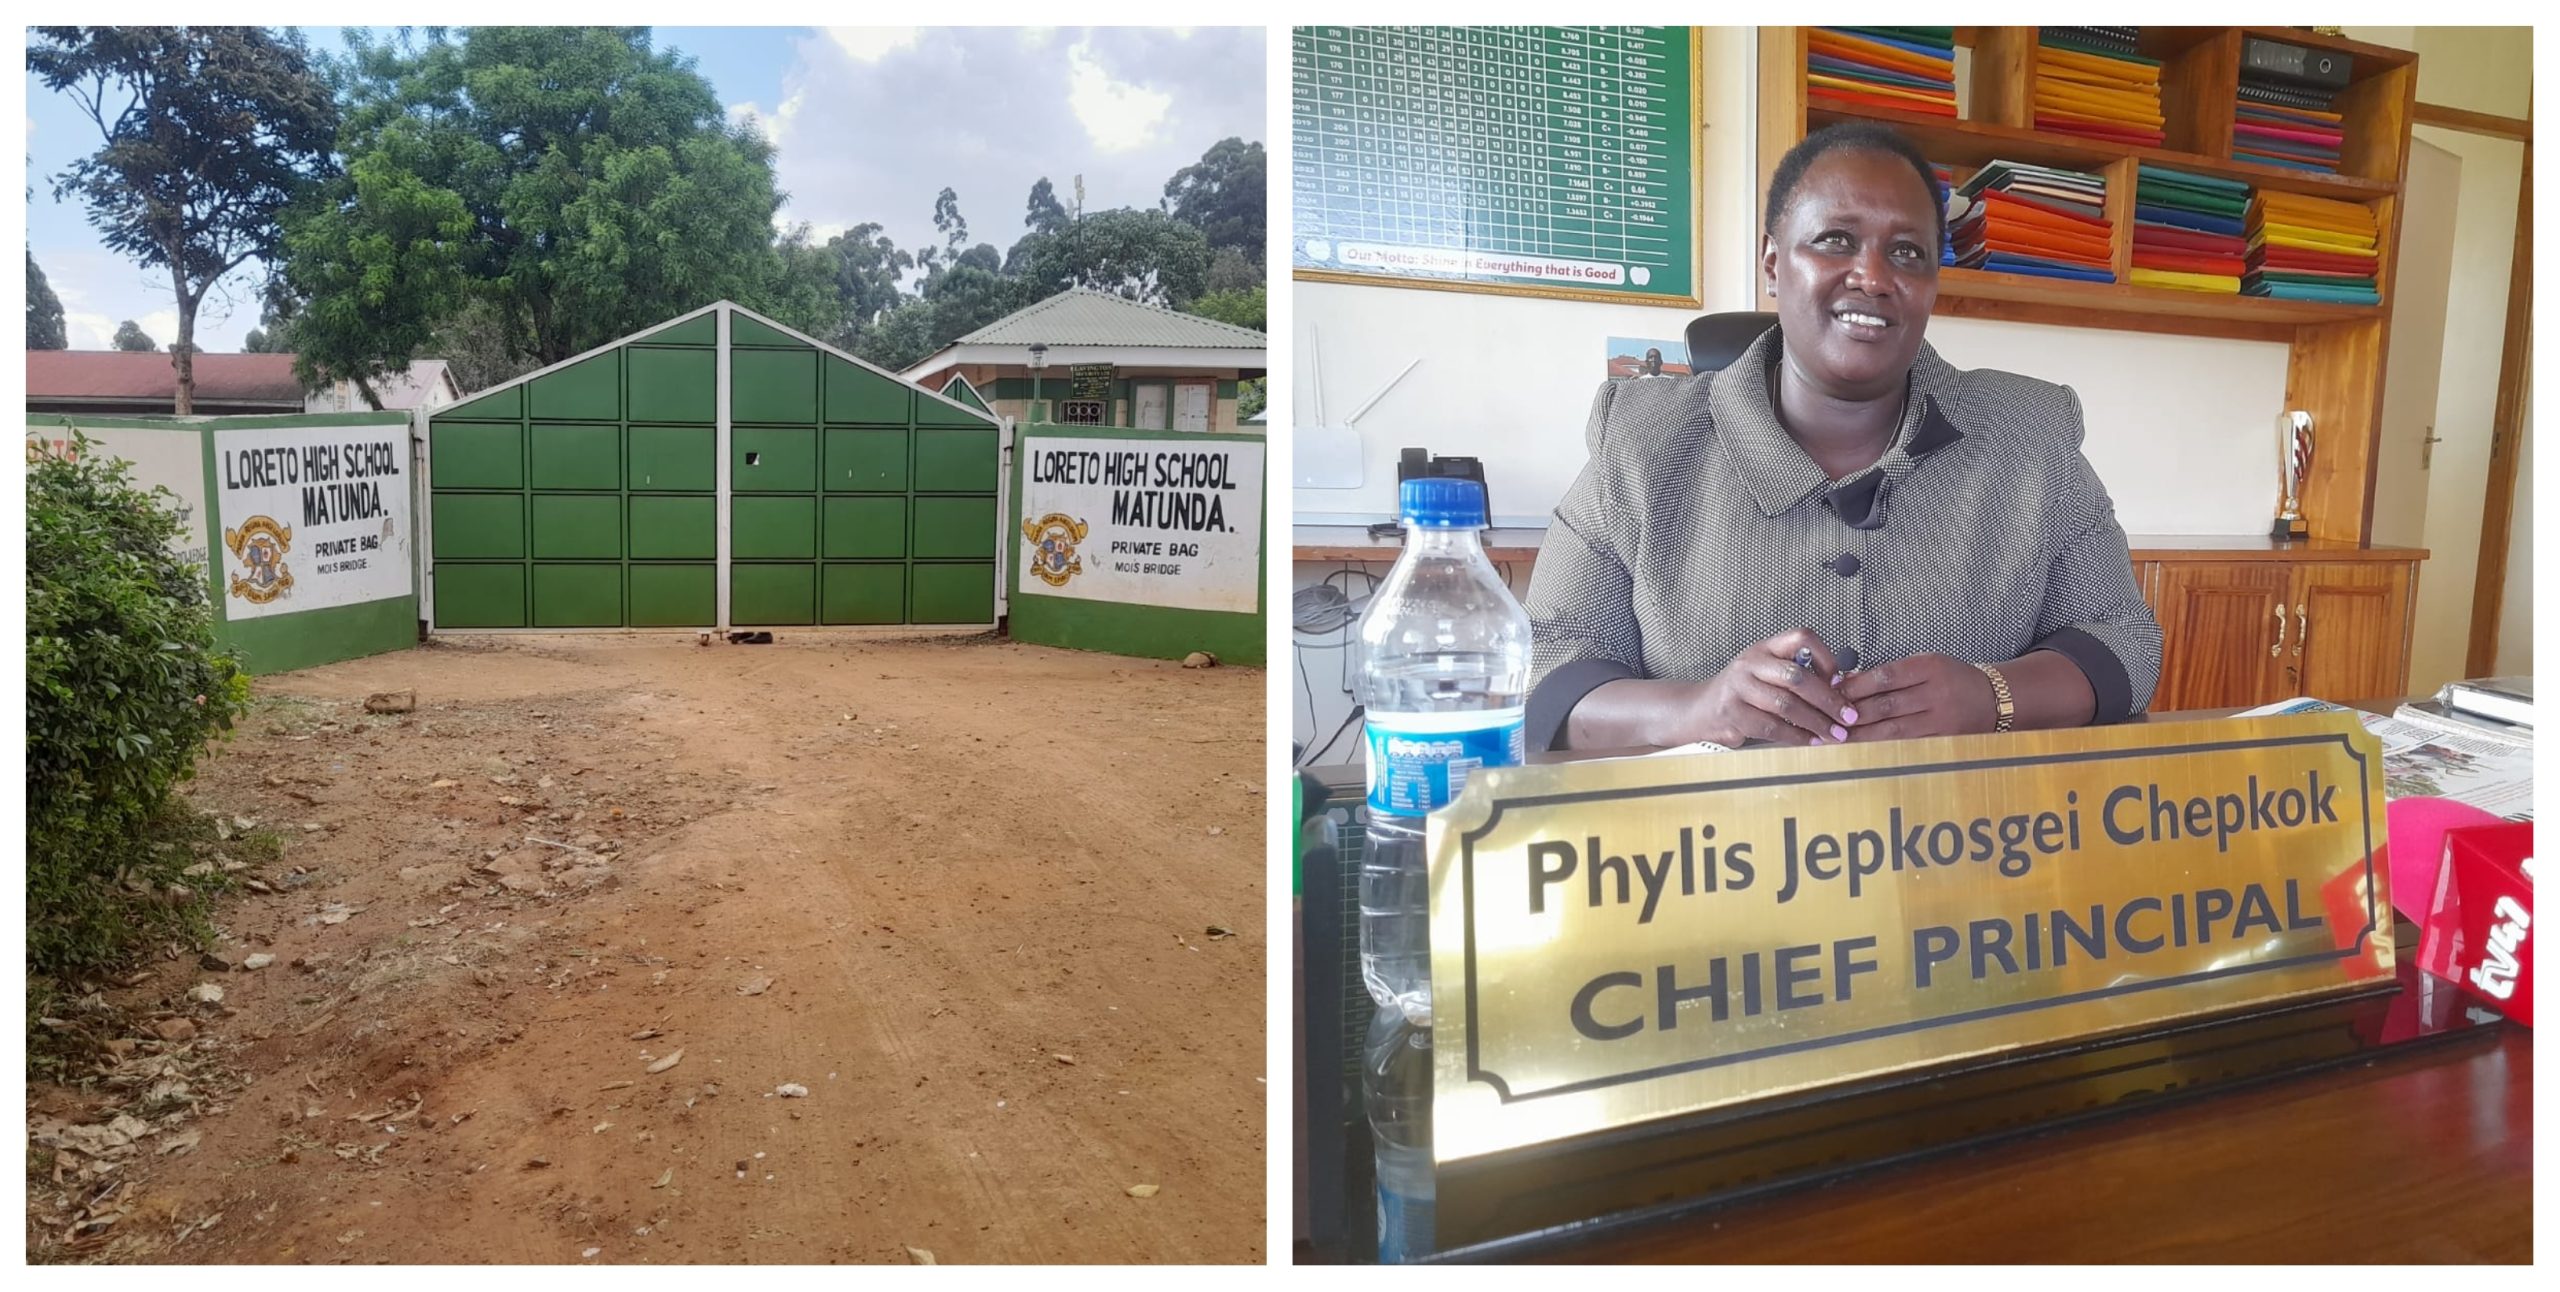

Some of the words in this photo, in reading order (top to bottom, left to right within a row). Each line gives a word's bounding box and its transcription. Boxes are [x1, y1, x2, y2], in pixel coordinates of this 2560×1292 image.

[1519, 41, 1524, 49] 0
[1520, 70, 1525, 78] 0
[1534, 58, 1540, 66] 0
[1362, 80, 1366, 88] 1
[1379, 82, 1383, 90] 1
[1507, 98, 1512, 106] 0
[1362, 96, 1369, 104] 0
[1381, 128, 1386, 136] 1
[1522, 130, 1528, 138] 0
[1537, 132, 1543, 140] 0
[1365, 156, 1371, 165] 0
[1510, 172, 1516, 181] 0
[1524, 174, 1528, 182] 1
[1538, 176, 1544, 184] 0
[1538, 160, 1544, 168] 0
[1348, 248, 1371, 261] Our
[1476, 258, 1542, 276] Everything
[1546, 264, 1570, 276] that
[1573, 266, 1582, 277] is
[1585, 267, 1616, 280] Good
[226, 447, 298, 489] LORETO
[303, 444, 339, 483] HIGH
[344, 442, 399, 478] SCHOOL
[1033, 450, 1100, 485] LORETO
[1104, 452, 1147, 486] HIGH
[1154, 453, 1236, 490] SCHOOL
[302, 481, 388, 528] MATUNDA.
[1112, 490, 1235, 533] MATUNDA.
[315, 538, 356, 558] PRIVATE
[360, 534, 378, 551] BAG
[1111, 541, 1162, 555] PRIVATE
[1169, 543, 1198, 557] BAG
[1143, 563, 1181, 575] BRIDGE
[1528, 824, 1756, 925] Phylis
[1776, 790, 2080, 904] Jepkosgei
[2103, 770, 2339, 853] Chepkok
[1570, 936, 1878, 1041] CHIEF
[1914, 878, 2322, 988] PRINCIPAL
